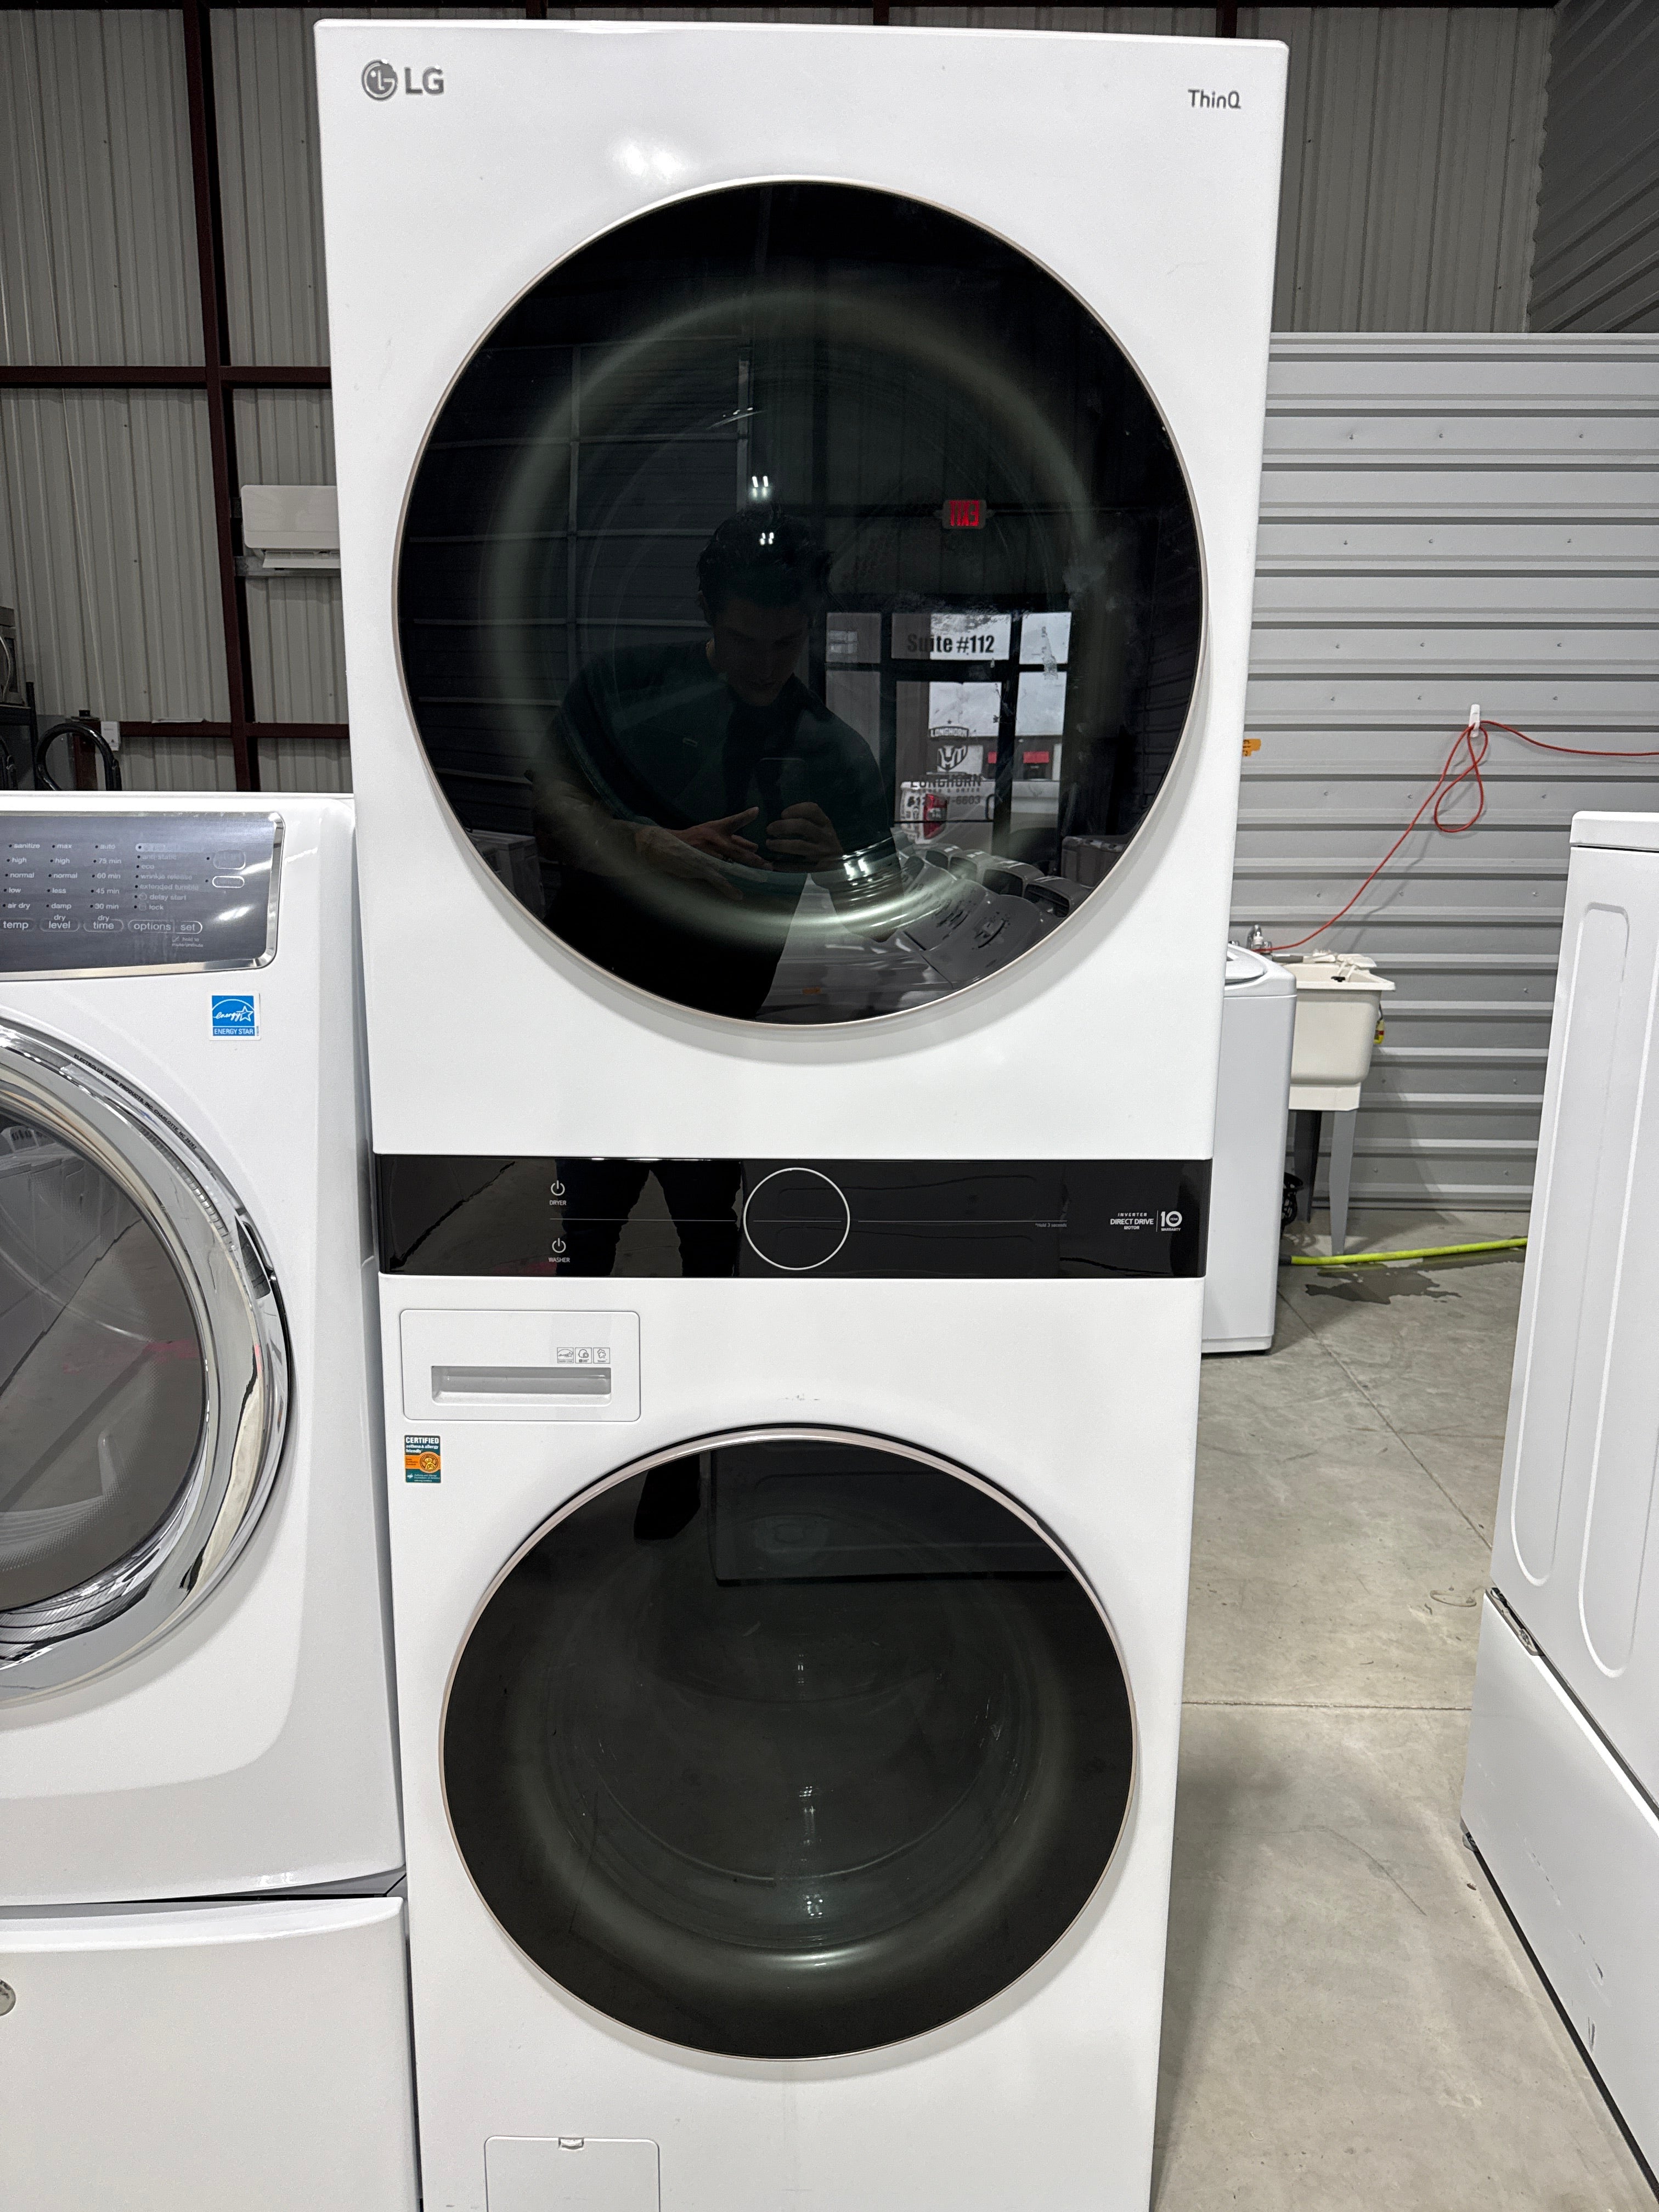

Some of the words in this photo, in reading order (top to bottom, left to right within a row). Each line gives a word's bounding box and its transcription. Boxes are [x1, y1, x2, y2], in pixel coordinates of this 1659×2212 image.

[405, 66, 444, 94] LG
[1188, 89, 1241, 109] ThinQ
[908, 633, 952, 652] Suite
[957, 635, 994, 653] #112
[3, 921, 29, 931] temp
[93, 921, 114, 929] time
[134, 922, 171, 931] options
[74, 1054, 104, 1075] ELECTROLUX
[105, 1073, 119, 1084] HOME
[1160, 1210, 1183, 1227] 10
